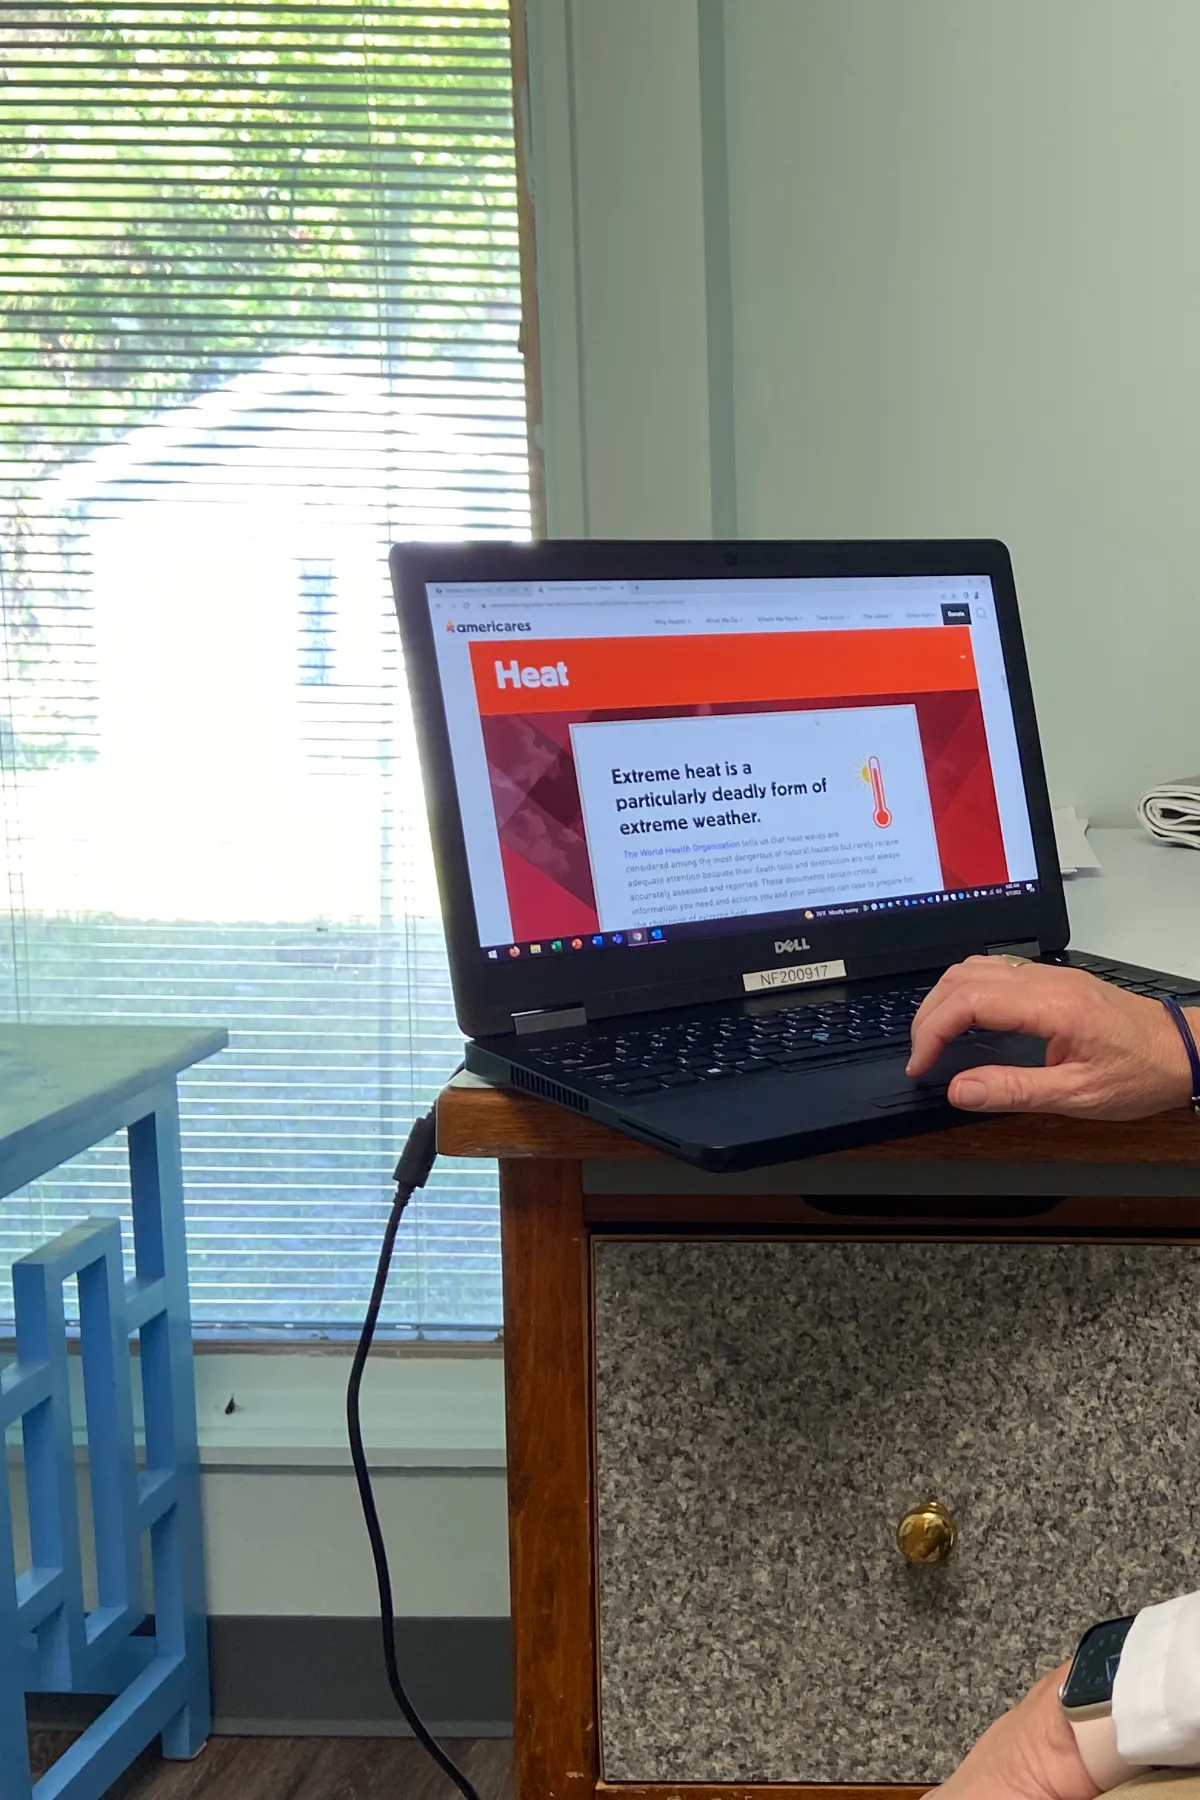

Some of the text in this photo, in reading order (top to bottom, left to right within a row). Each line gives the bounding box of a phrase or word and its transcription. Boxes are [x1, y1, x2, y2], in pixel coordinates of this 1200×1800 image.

[456, 620, 532, 632] americares
[494, 660, 569, 689] Heat
[611, 761, 752, 784] Extreme heat is a
[616, 778, 828, 812] particularly deadly form of
[620, 810, 761, 835] extreme weather.
[624, 850, 638, 858] The
[641, 848, 663, 856] World
[665, 846, 691, 854] Health
[693, 841, 740, 852] Organization
[771, 836, 785, 844] that
[787, 834, 802, 842] heat
[804, 832, 826, 840] waves
[626, 863, 669, 873] considered
[671, 859, 697, 869] among
[698, 856, 711, 865] the
[713, 855, 732, 863] most
[734, 852, 773, 863] dangerous
[783, 846, 809, 856] natural
[811, 844, 839, 853] hazards
[853, 840, 873, 849] rarely
[875, 838, 899, 847] receive
[628, 877, 664, 887] adequate
[666, 873, 700, 883] attention
[702, 870, 734, 879] because
[735, 867, 752, 875] their
[754, 865, 776, 873] death
[777, 863, 793, 871] tolls
[795, 861, 808, 869] and
[810, 857, 850, 867] destruction
[877, 852, 900, 861] always
[630, 867, 878, 901] accurately assessed and reported. These documents contain critical
[632, 903, 678, 915] information
[680, 903, 693, 912] you
[695, 900, 713, 908] need
[716, 897, 729, 905] and
[731, 894, 758, 904] actions
[760, 894, 773, 903] you
[774, 891, 787, 899] and
[789, 890, 805, 899] your
[807, 885, 836, 896] patients
[876, 878, 902, 888] prepare
[688, 914, 696, 922] of
[774, 938, 810, 953] DELL
[760, 965, 828, 986] NF200917
